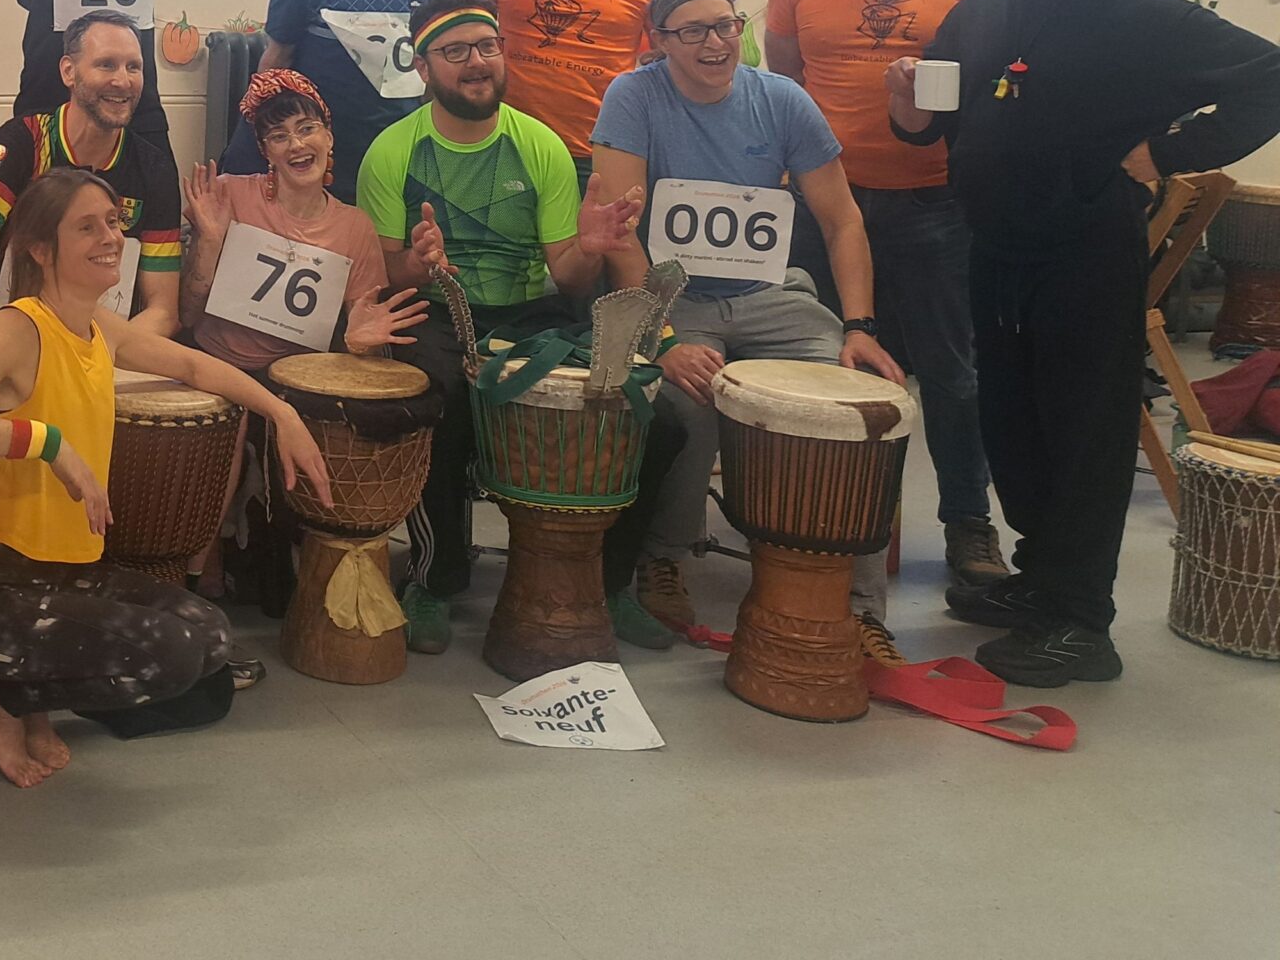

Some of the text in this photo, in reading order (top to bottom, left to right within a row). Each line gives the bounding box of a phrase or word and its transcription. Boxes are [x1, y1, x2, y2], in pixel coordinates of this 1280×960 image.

[566, 61, 605, 76] Energy
[665, 203, 778, 251] 006
[251, 252, 322, 317] 76
[535, 706, 607, 733] neuf
